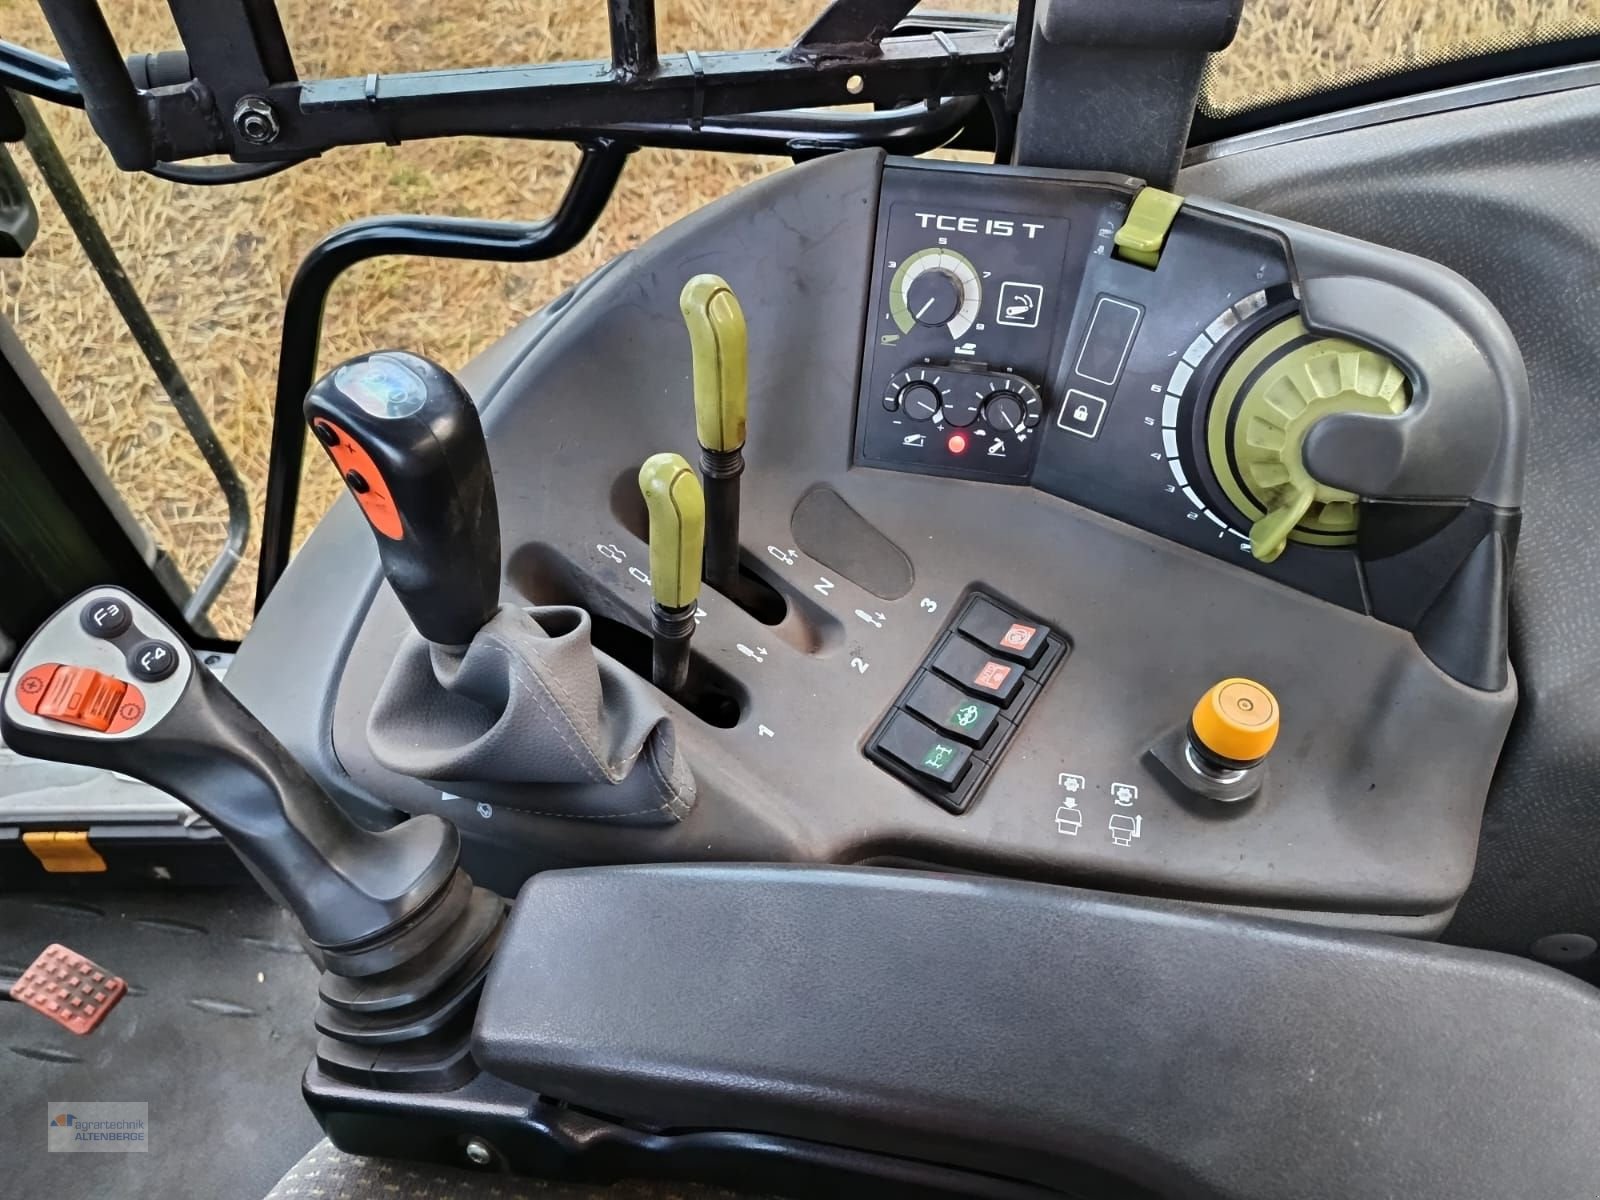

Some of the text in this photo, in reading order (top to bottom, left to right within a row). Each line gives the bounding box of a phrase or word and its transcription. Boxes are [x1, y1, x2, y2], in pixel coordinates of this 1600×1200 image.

[915, 213, 1045, 239] TCE 15 T
[938, 237, 947, 245] 5
[1150, 383, 1163, 393] 6
[1143, 416, 1156, 427] 5
[1150, 452, 1162, 461] 4
[1164, 484, 1176, 493] 3
[1186, 511, 1198, 520] 2
[814, 576, 834, 596] N
[920, 597, 937, 613] 3
[94, 604, 119, 626] F3
[141, 647, 166, 671] F4
[850, 657, 869, 674] 2
[758, 724, 775, 738] 1
